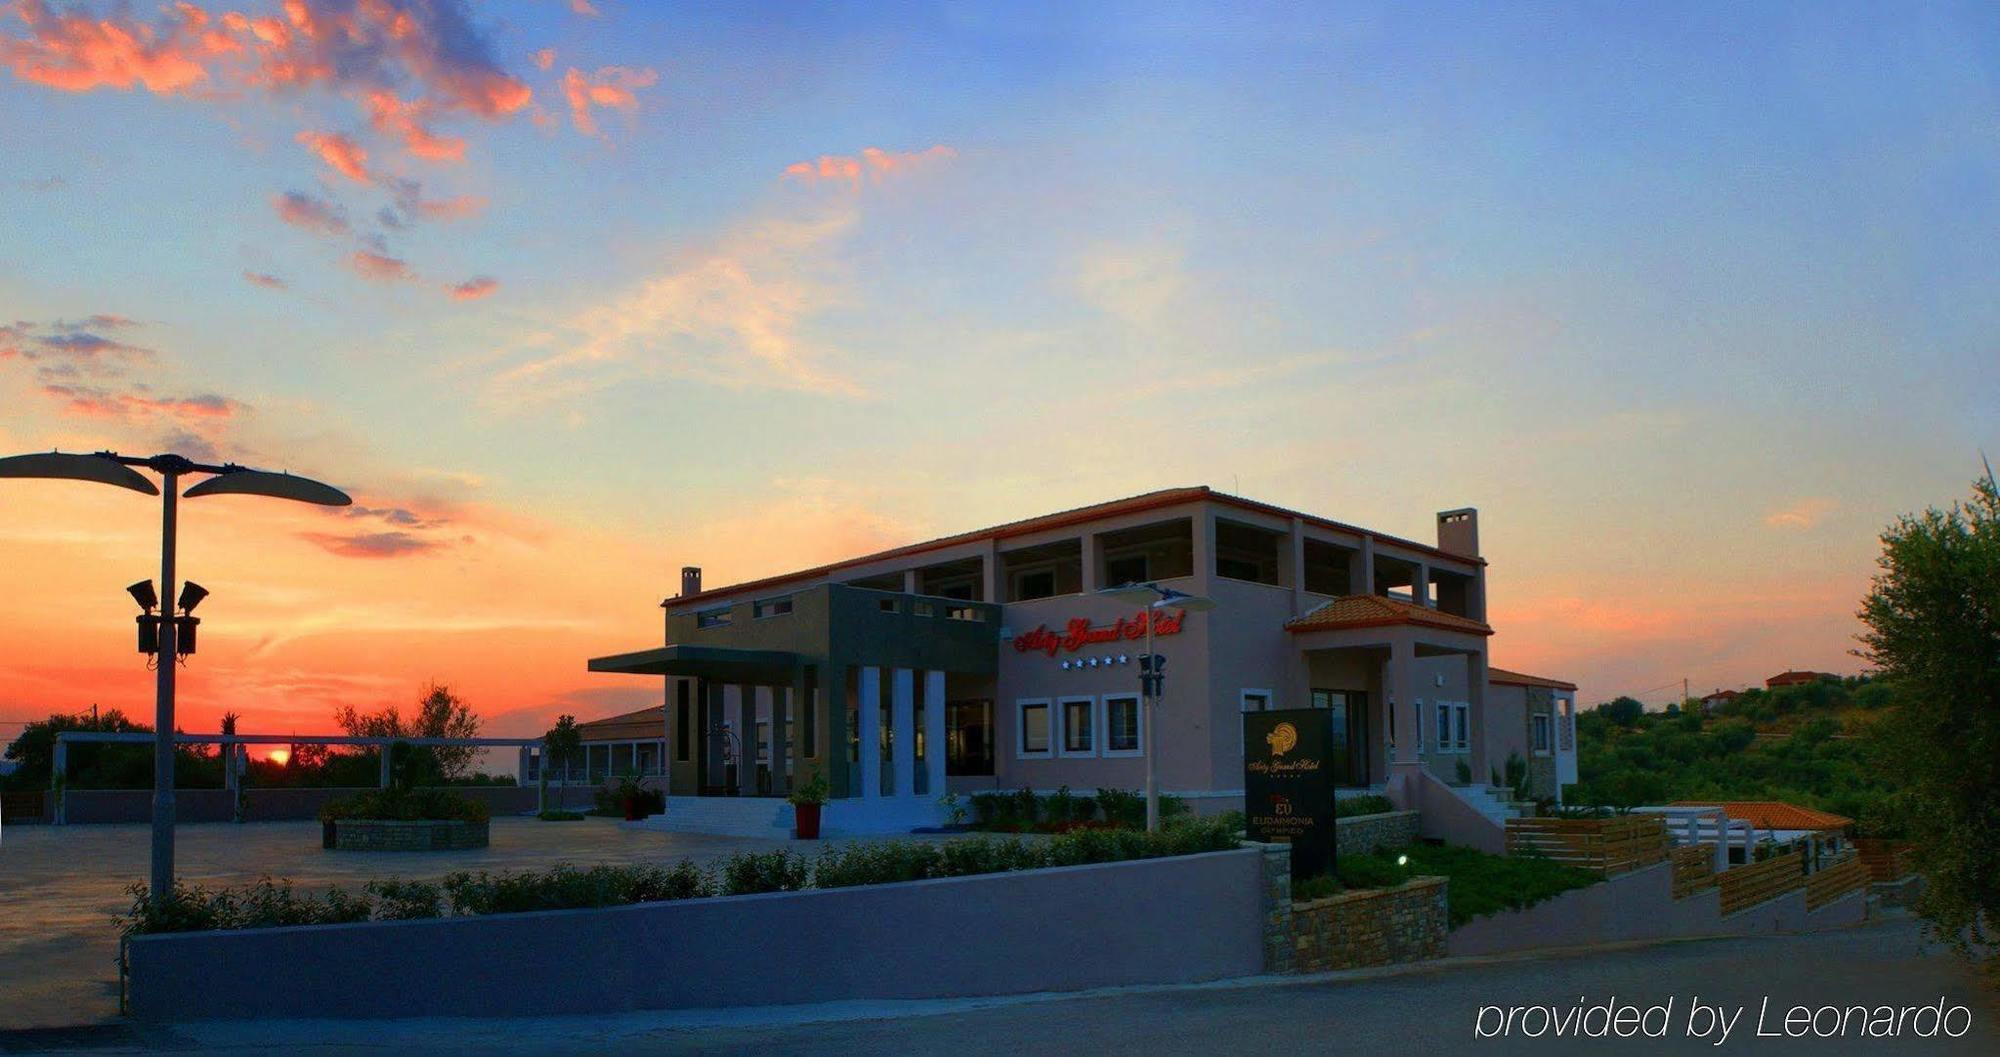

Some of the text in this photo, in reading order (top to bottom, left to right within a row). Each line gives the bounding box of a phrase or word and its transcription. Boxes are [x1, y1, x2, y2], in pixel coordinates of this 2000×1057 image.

[1063, 616, 1124, 652] Grand
[1123, 609, 1186, 641] Hotel
[1269, 760, 1296, 773] Grand
[1295, 758, 1320, 771] Hotel
